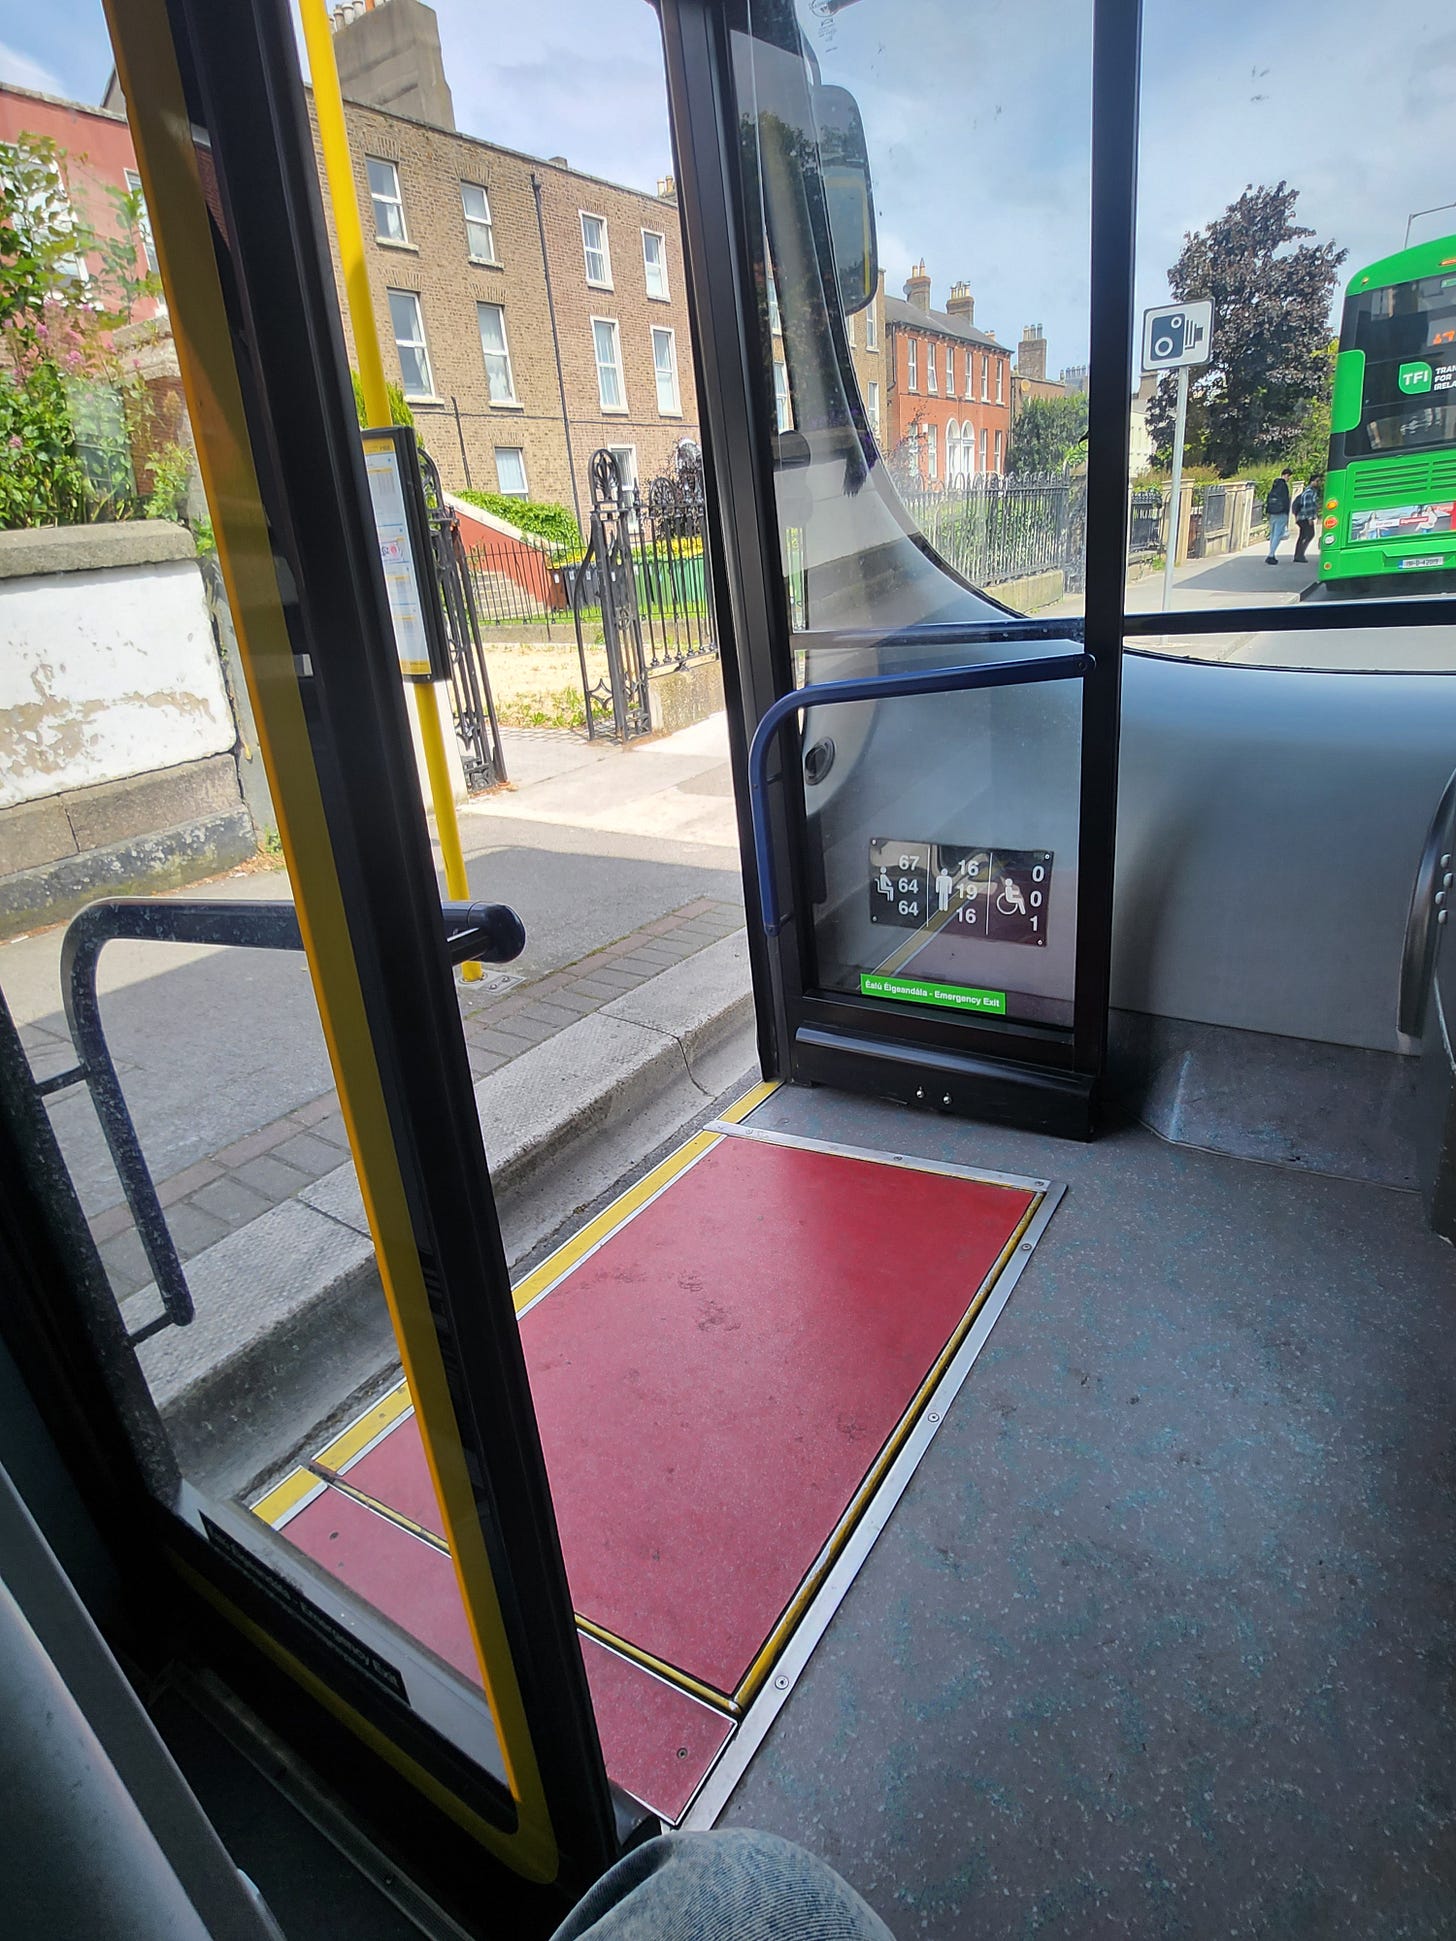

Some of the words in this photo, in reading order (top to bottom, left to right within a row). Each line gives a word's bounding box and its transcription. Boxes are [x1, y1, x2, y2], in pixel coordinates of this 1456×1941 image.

[1403, 370, 1428, 386] TFI
[1434, 373, 1452, 383] FOR
[899, 855, 919, 871] 67
[958, 860, 979, 876] 16
[1032, 865, 1045, 882] 0
[898, 878, 919, 894] 64
[956, 883, 978, 900] 19
[1030, 890, 1042, 907] 0
[898, 901, 919, 916] 64
[956, 908, 977, 924] 16
[1029, 915, 1038, 932] 1
[934, 990, 981, 1006] Emergency
[983, 997, 1000, 1008] Exit
